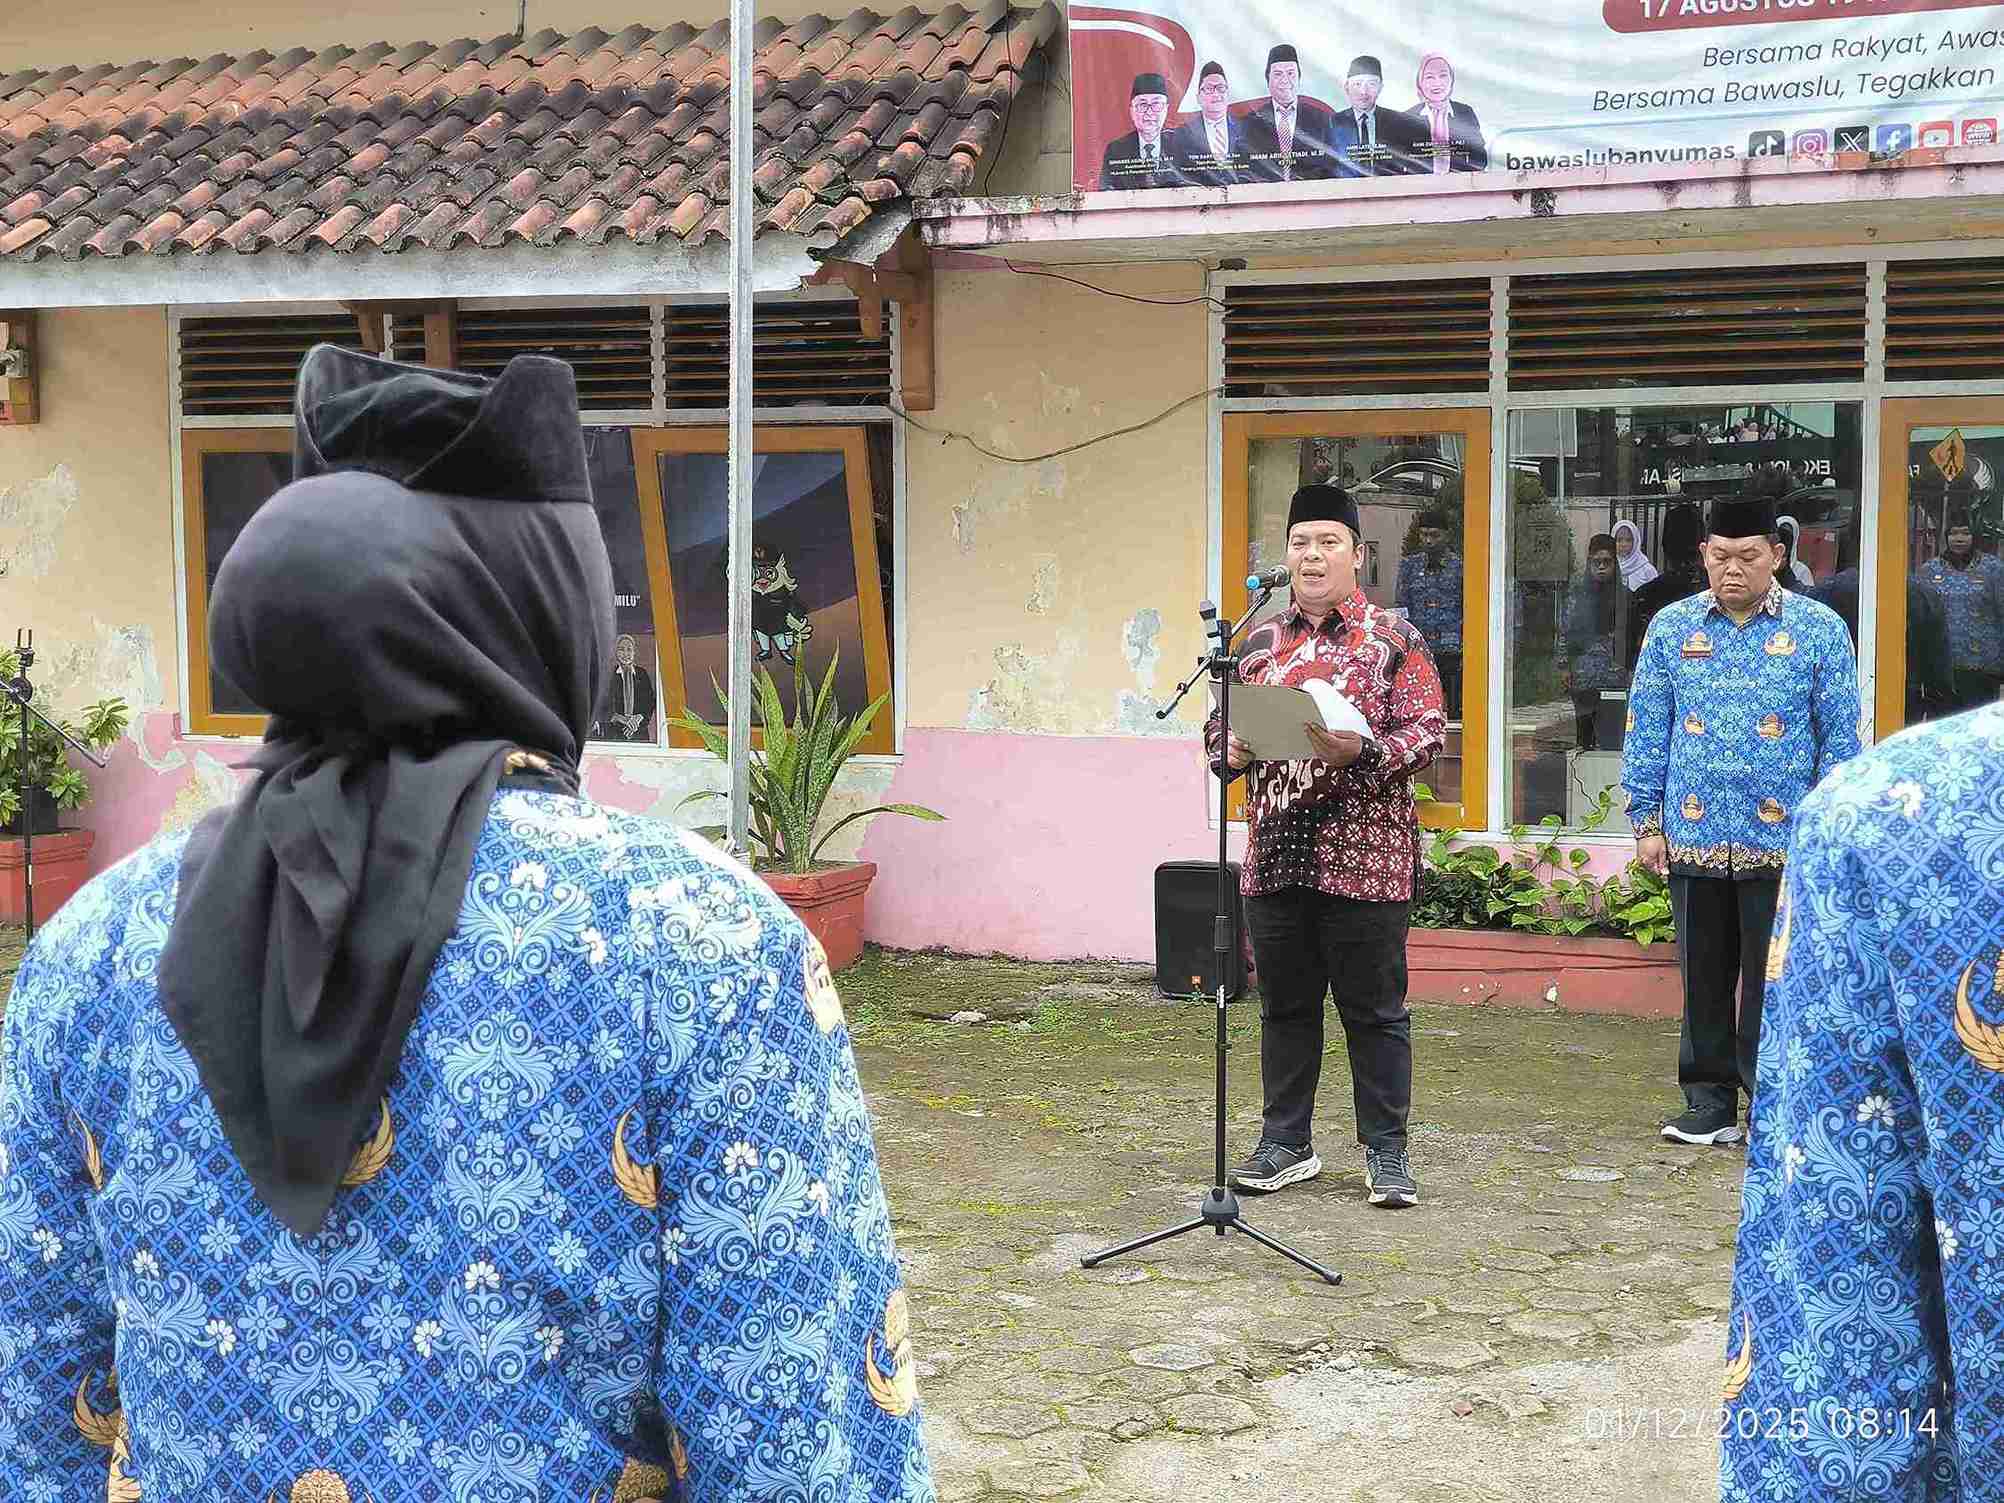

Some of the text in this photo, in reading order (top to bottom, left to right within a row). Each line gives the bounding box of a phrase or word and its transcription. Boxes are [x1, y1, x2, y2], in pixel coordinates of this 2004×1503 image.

[1703, 43, 1823, 67] Bersama
[1831, 32, 1928, 61] Rakyat,
[1592, 67, 1995, 111] Bersama Bawaslu, Tegakkan
